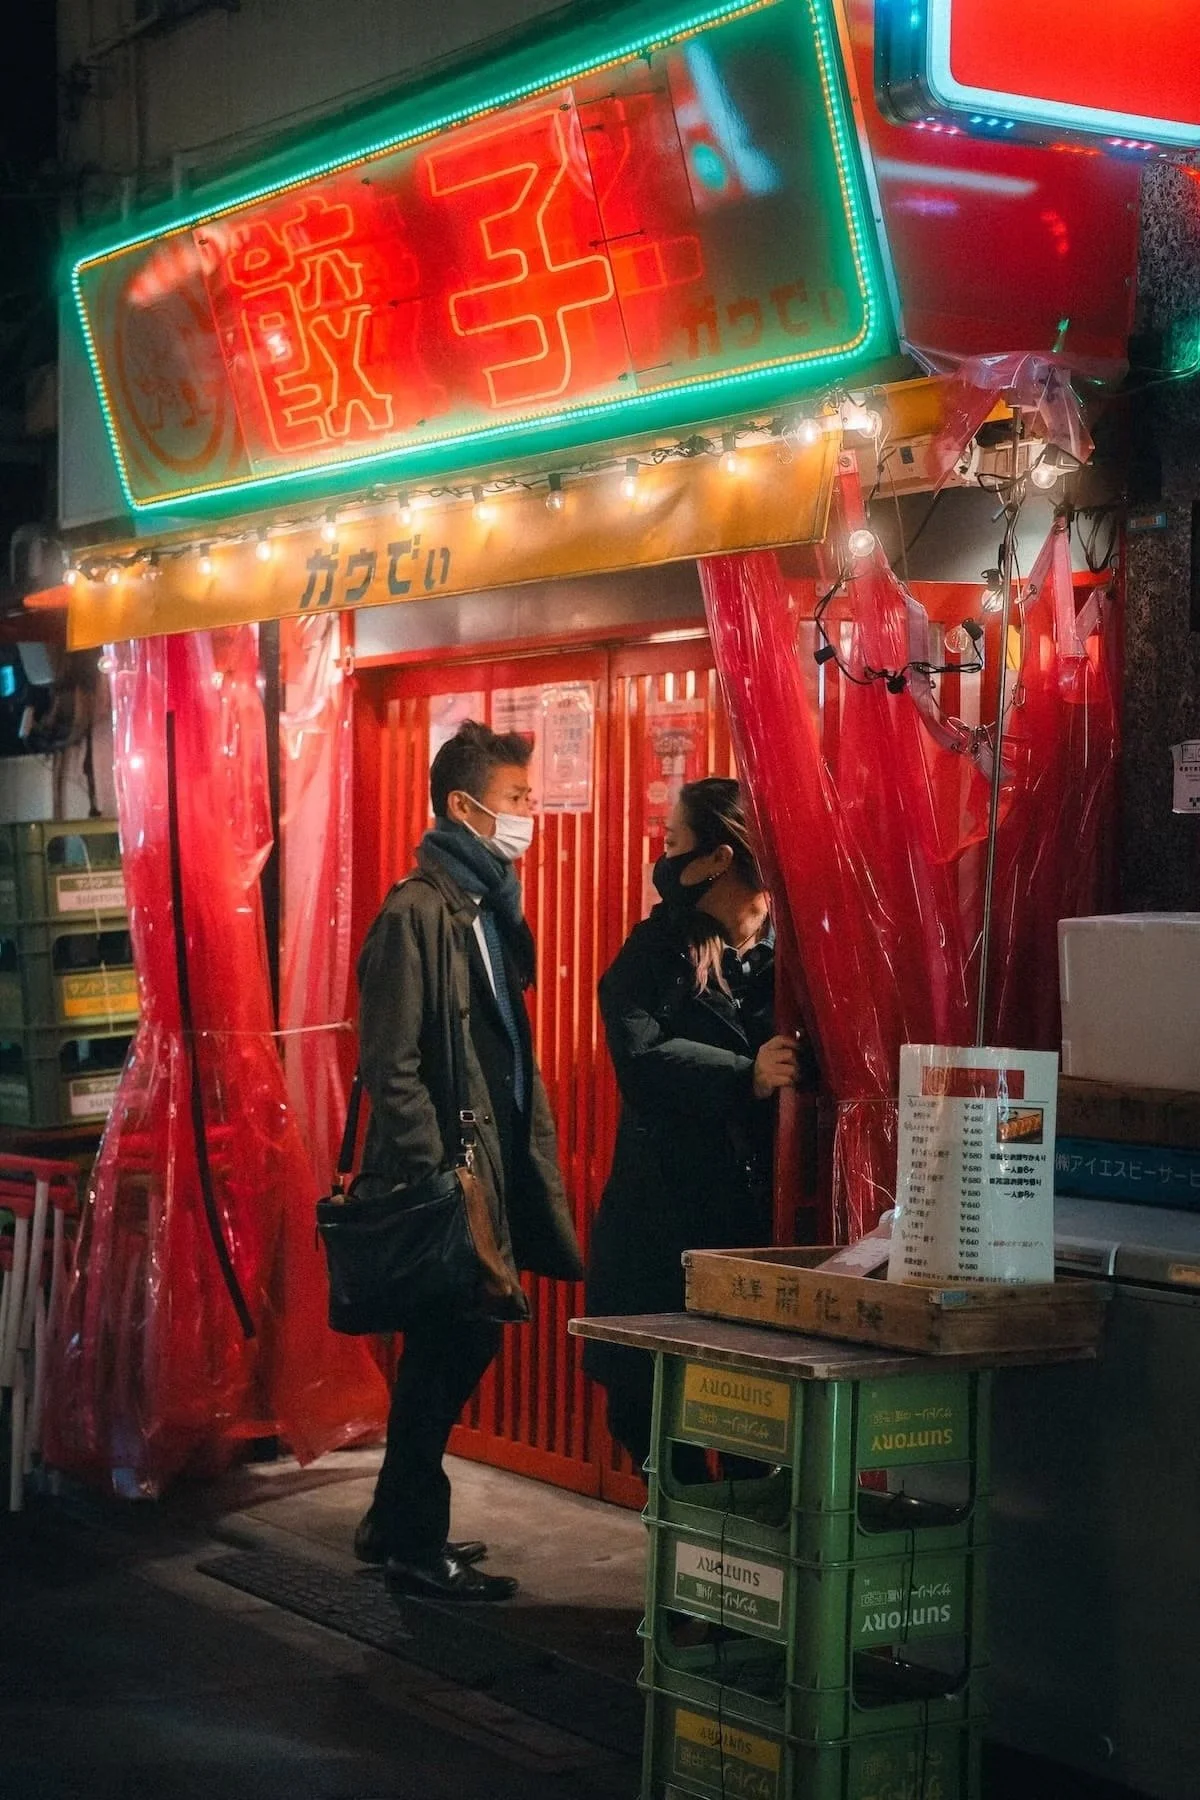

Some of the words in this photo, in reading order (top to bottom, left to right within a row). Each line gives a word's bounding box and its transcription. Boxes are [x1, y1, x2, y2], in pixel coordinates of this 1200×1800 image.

[699, 1377, 773, 1407] SUNTORY
[871, 1428, 953, 1452] SUNTORY
[696, 1555, 761, 1587] SUNTORY
[717, 1591, 758, 1615] サントリー
[910, 1583, 952, 1599] サントリー
[860, 1603, 952, 1633] SUNTORY
